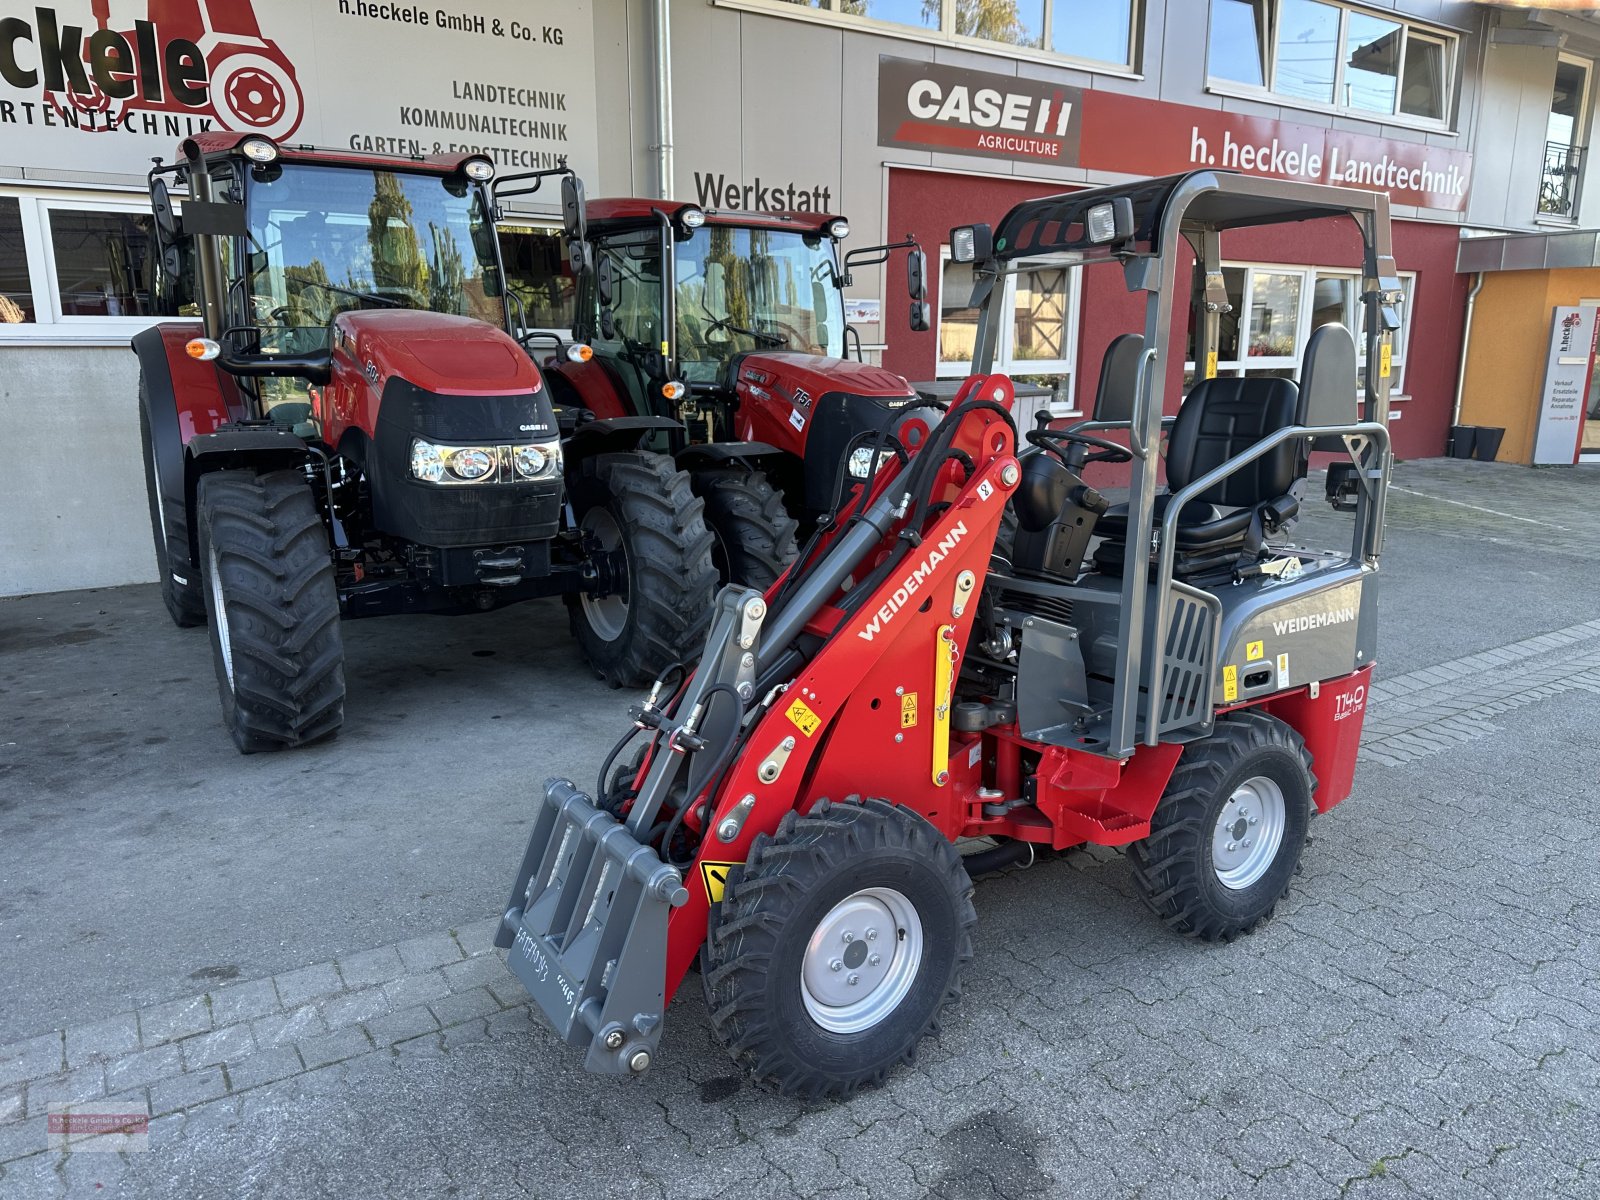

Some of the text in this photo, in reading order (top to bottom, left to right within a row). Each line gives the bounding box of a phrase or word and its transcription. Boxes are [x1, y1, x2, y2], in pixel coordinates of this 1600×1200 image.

[338, 0, 564, 45] h.heckele GmbH & Co. KG
[452, 80, 567, 111] LANDTECHNIK
[907, 79, 1032, 131] CASE
[399, 106, 568, 141] KOMMUNALTECHNIK
[349, 134, 427, 155] GARTEN-
[432, 142, 445, 155] &
[977, 134, 1058, 156] AGRICULTURE
[1190, 126, 1466, 196] h. heckele Landtechnik
[694, 172, 831, 214] Werkstatt
[793, 387, 812, 408] 75A
[857, 520, 969, 641] WEIDEMANN
[1272, 607, 1355, 636] WEIDEMANN
[1335, 685, 1365, 713] 1140
